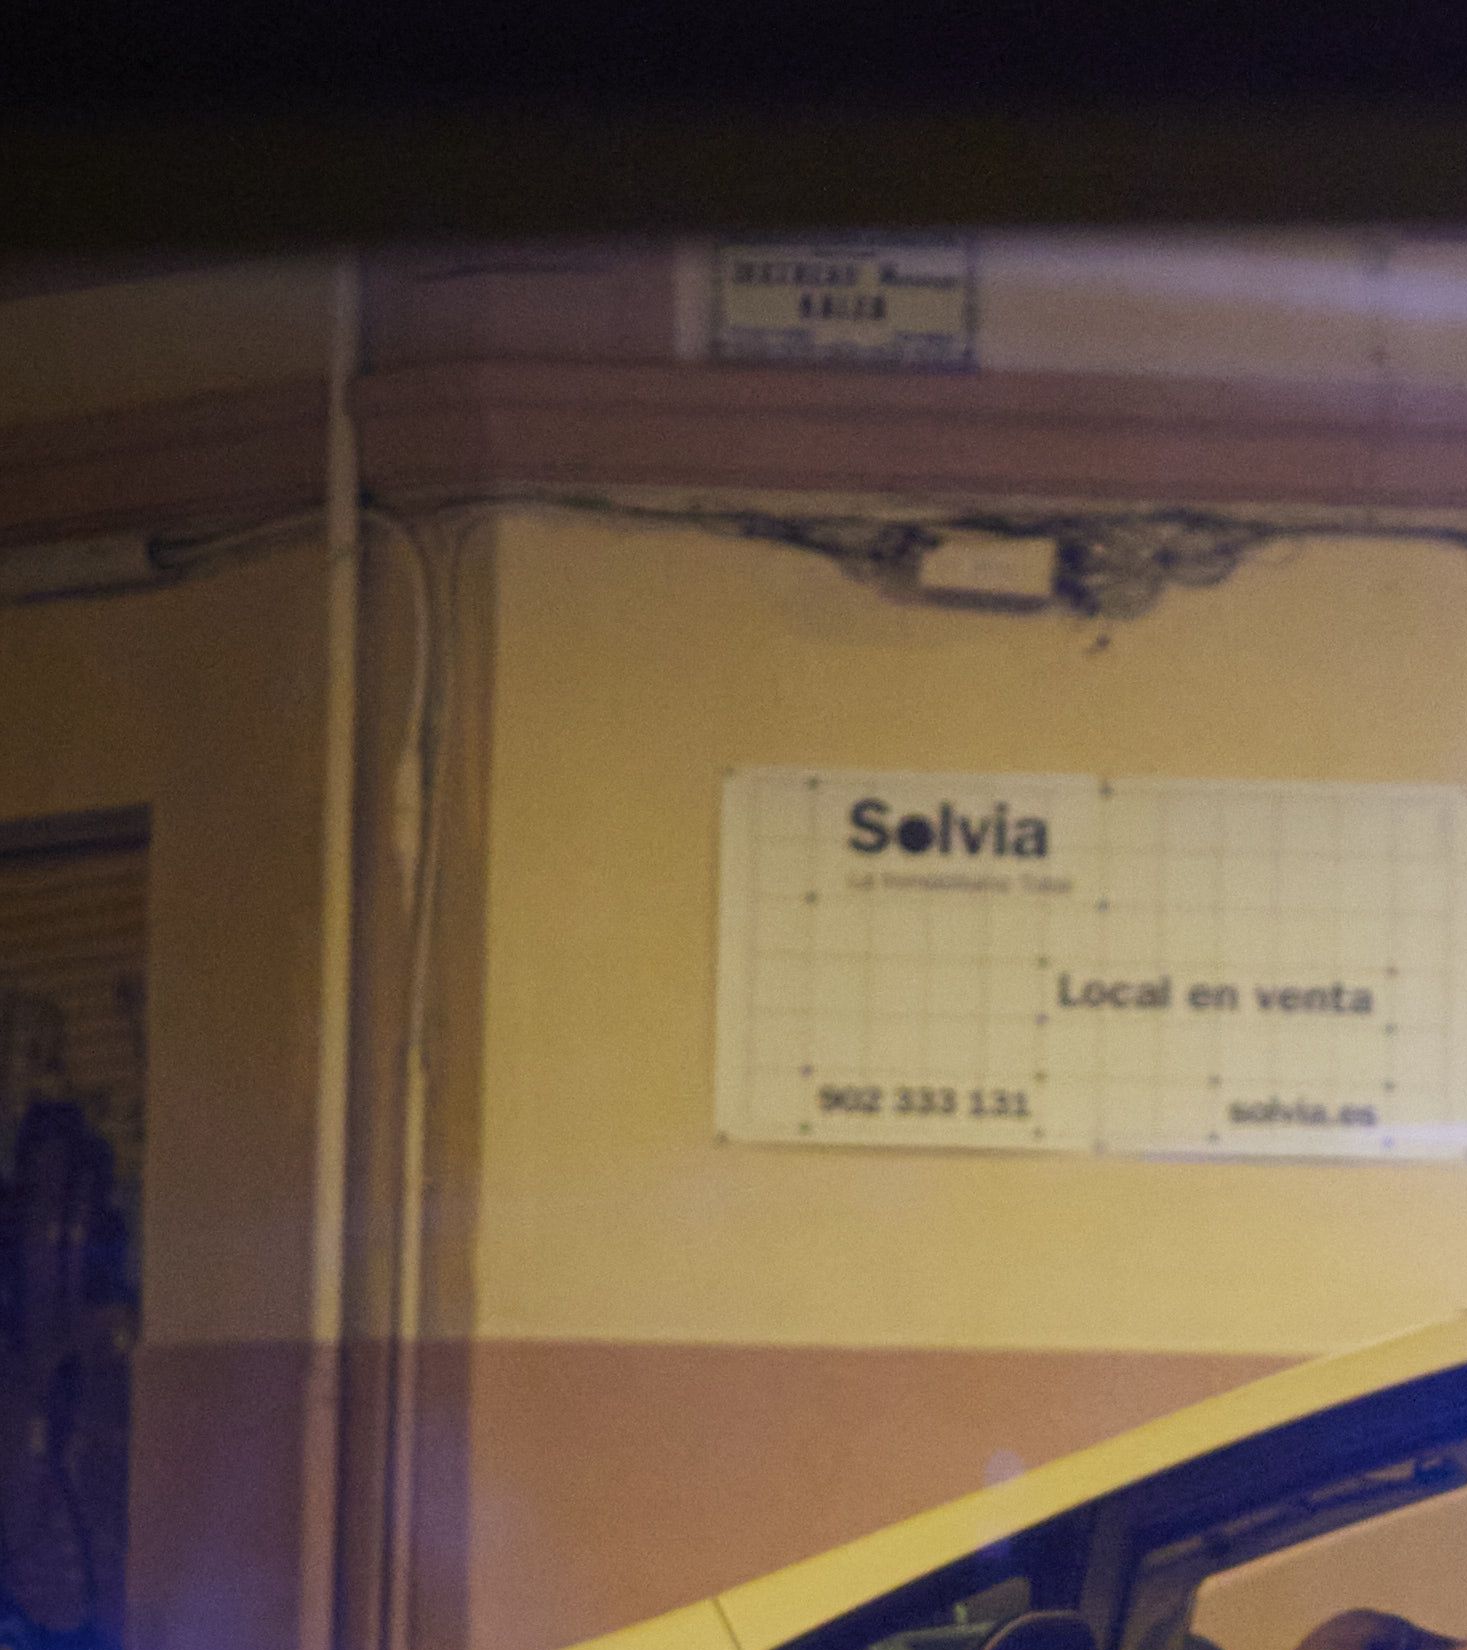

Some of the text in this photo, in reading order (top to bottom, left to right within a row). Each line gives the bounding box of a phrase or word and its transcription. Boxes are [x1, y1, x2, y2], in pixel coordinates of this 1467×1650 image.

[847, 797, 1050, 860] Solvia
[1057, 972, 1373, 1015] Local en venta
[1228, 1096, 1378, 1128] solvia.es
